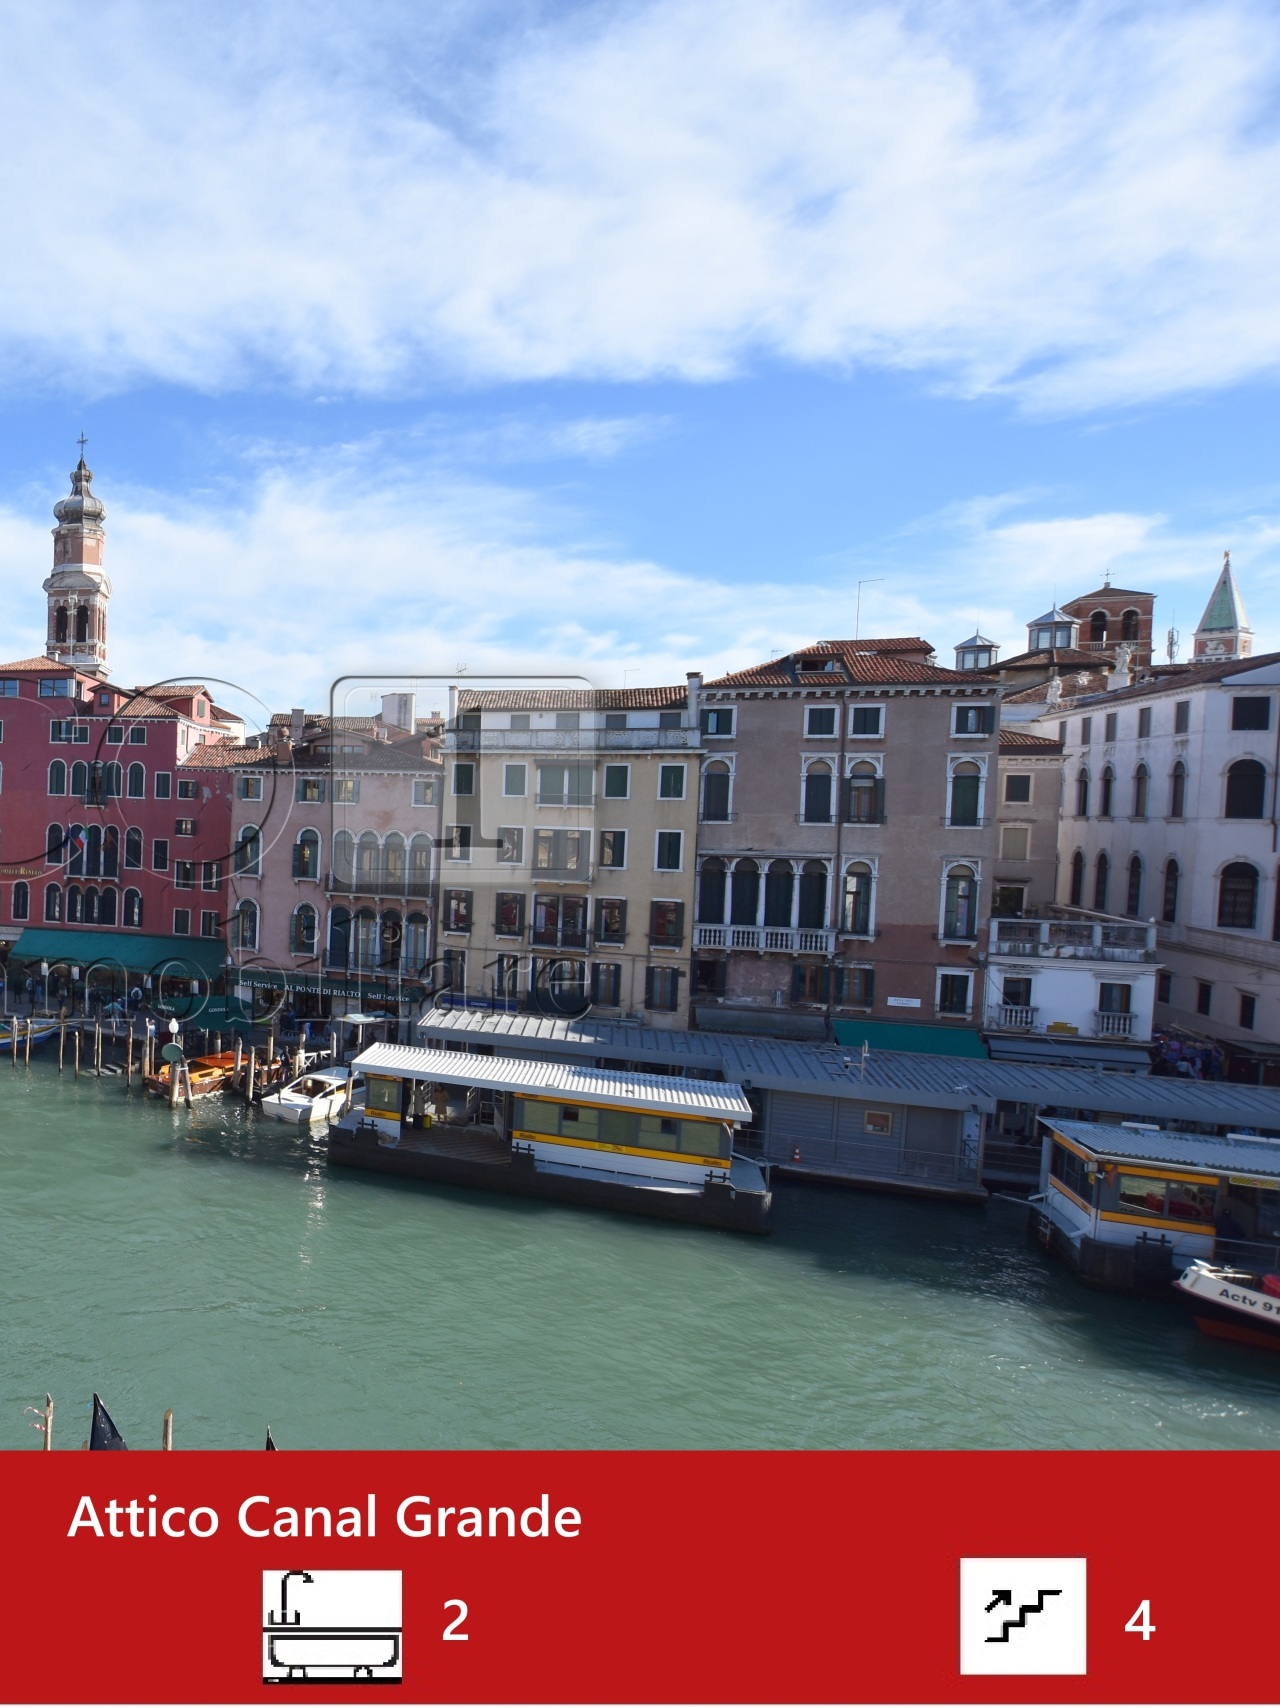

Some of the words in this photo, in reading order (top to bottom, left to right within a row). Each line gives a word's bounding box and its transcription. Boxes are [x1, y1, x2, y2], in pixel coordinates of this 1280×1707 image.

[239, 980, 253, 988] Self
[254, 980, 278, 990] Service
[284, 984, 295, 992] AL
[295, 985, 321, 994] PONTE
[322, 988, 332, 996] DI
[333, 989, 361, 998] RIALTO
[368, 992, 382, 1000] Self
[383, 993, 410, 1002] Service
[519, 1132, 537, 1140] Rialto
[703, 1158, 722, 1167] Rialto
[1219, 1288, 1257, 1307] Actv
